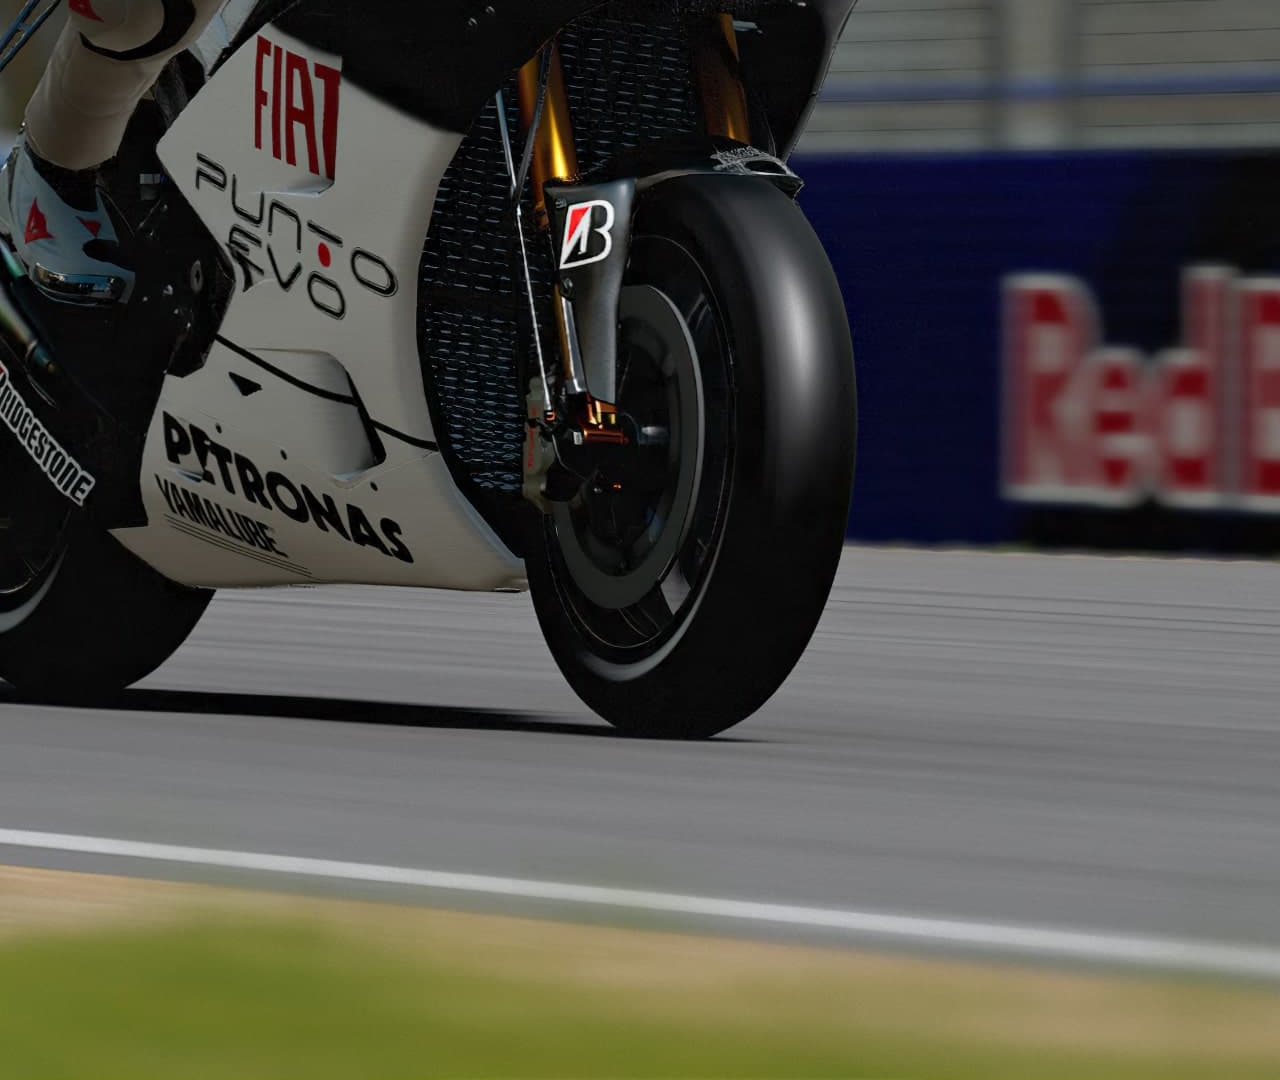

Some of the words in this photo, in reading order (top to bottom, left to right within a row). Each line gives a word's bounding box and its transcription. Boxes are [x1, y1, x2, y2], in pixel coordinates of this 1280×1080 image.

[254, 34, 342, 183] FIAT
[195, 152, 399, 298] PUNTO
[226, 223, 347, 321] EVO
[154, 473, 290, 559] YAMALUBE
[162, 410, 415, 564] PETRONAS
